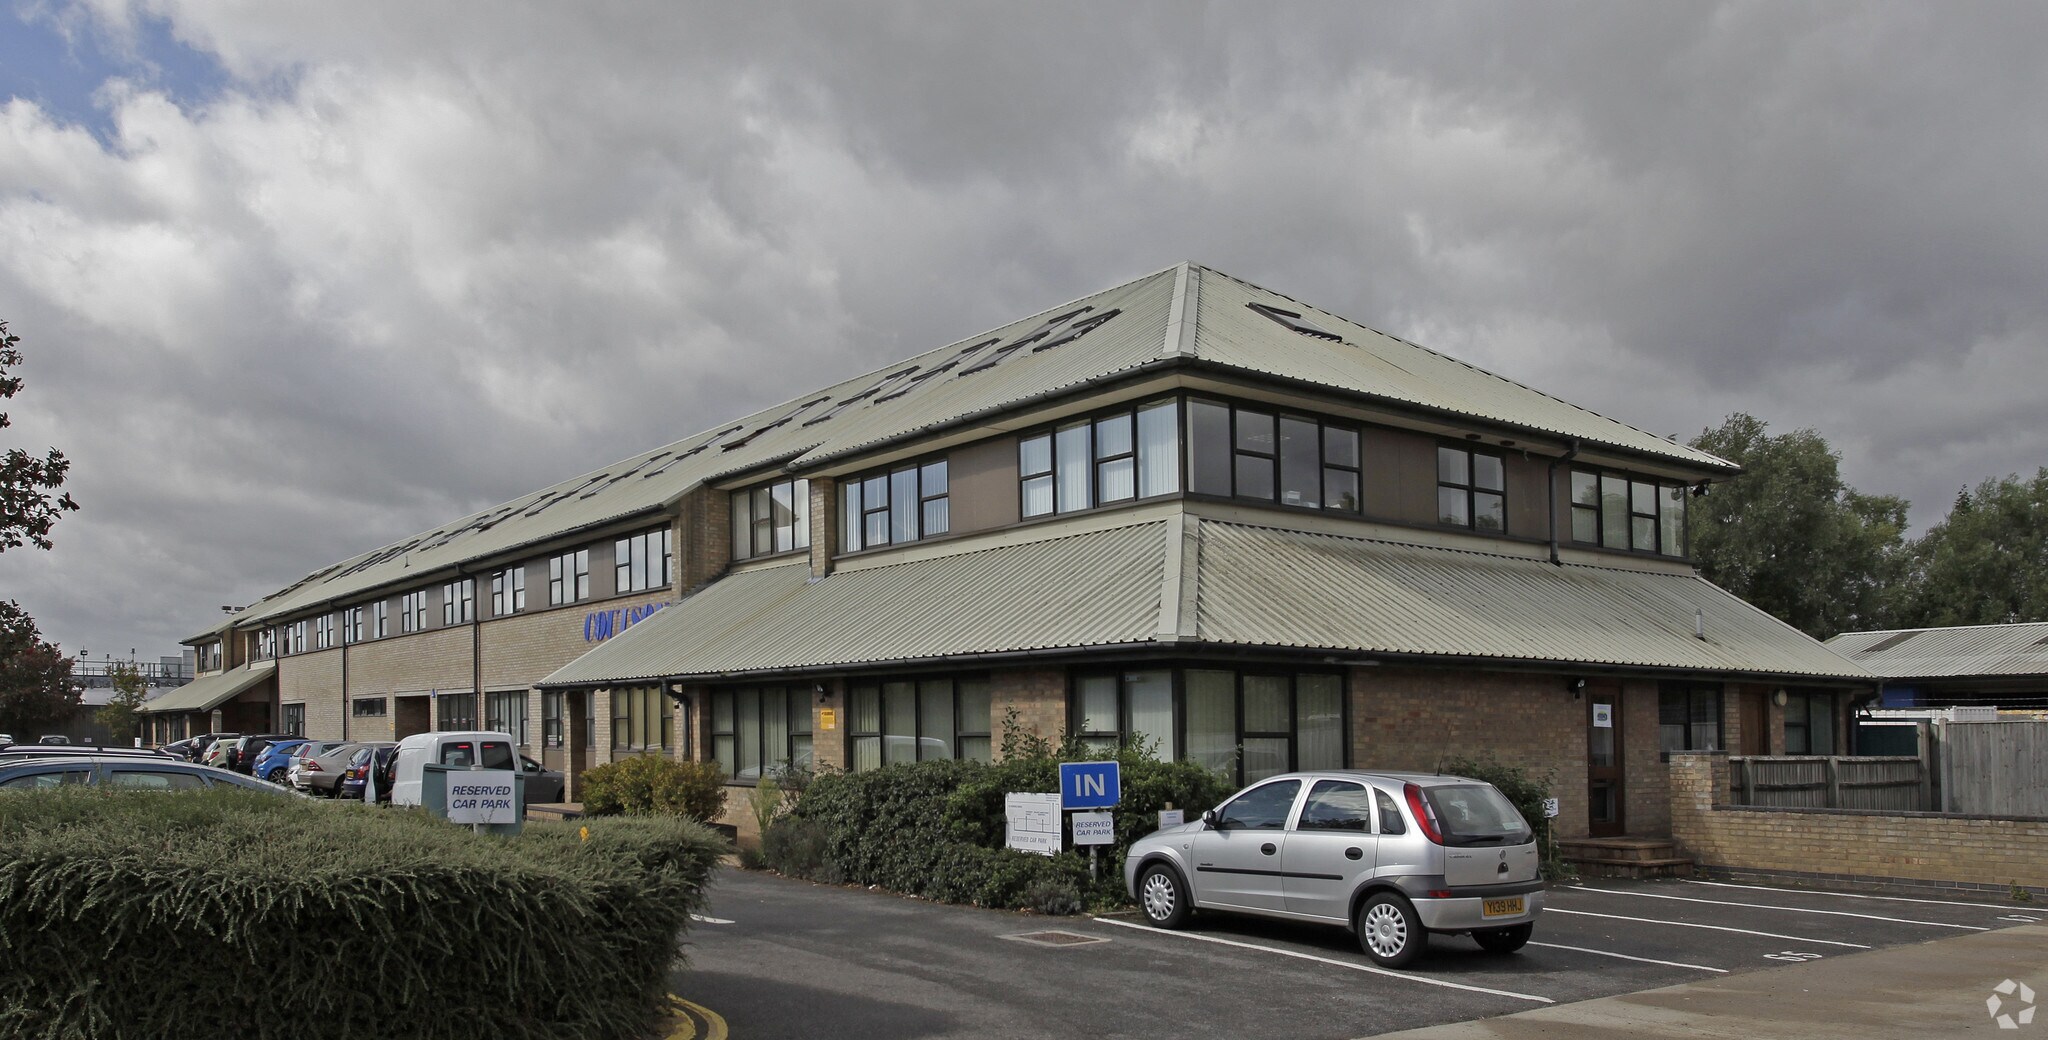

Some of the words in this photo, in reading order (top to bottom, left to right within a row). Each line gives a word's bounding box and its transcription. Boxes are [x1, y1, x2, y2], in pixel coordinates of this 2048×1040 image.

[1075, 773, 1105, 797] IN
[452, 785, 511, 796] RESERVED
[452, 799, 477, 809] CAR
[481, 799, 511, 809] PARK
[1076, 820, 1111, 829] RESERVED
